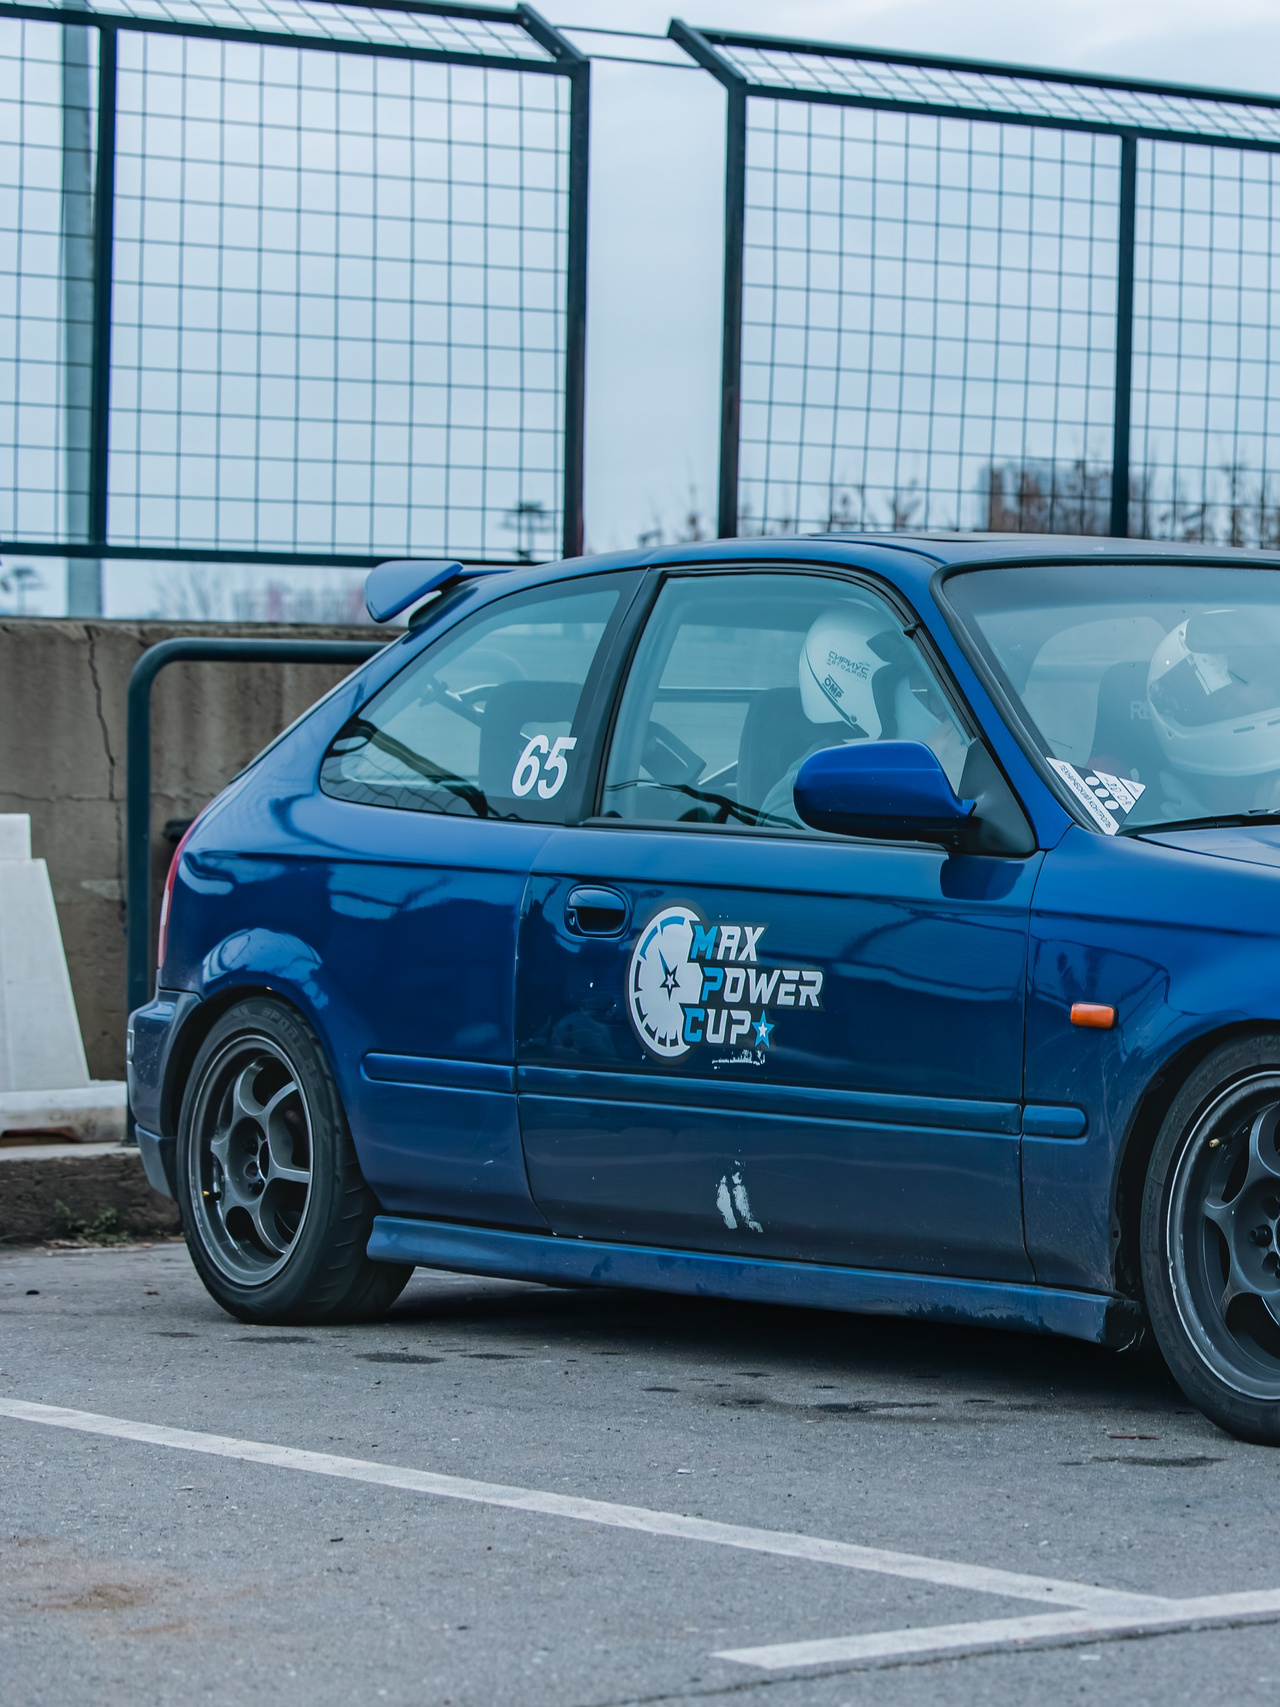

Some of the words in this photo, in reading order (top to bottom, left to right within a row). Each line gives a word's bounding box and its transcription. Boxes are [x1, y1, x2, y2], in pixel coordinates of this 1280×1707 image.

[824, 677, 842, 698] OMP
[511, 734, 578, 800] 65
[690, 925, 765, 962] MAX
[701, 966, 824, 1007] POWER
[683, 1007, 752, 1045] CUP
